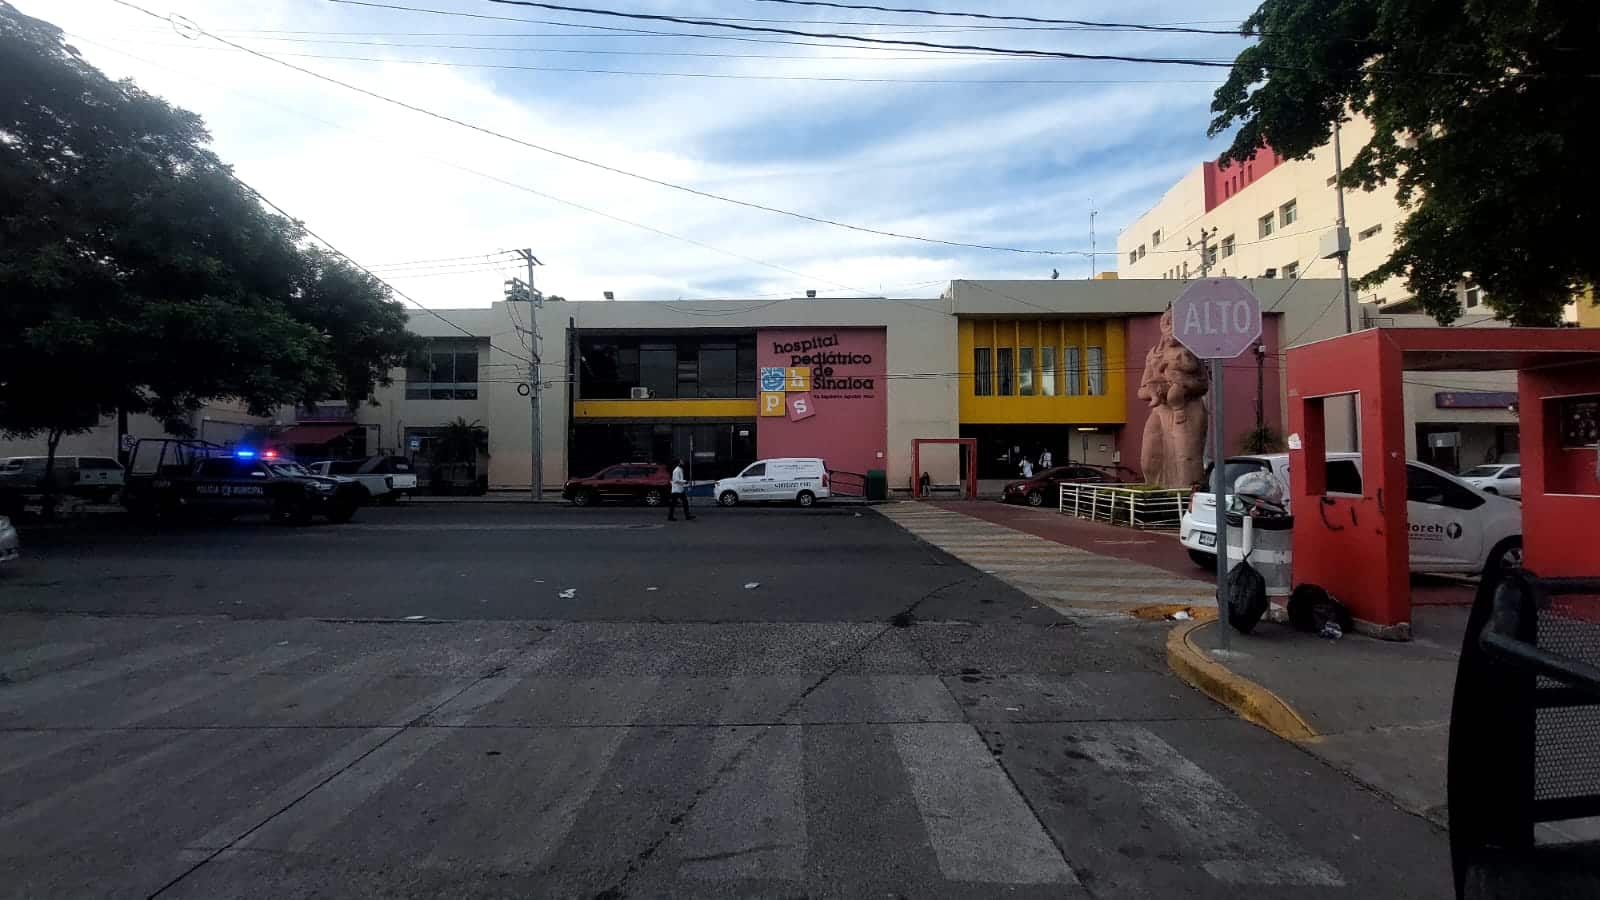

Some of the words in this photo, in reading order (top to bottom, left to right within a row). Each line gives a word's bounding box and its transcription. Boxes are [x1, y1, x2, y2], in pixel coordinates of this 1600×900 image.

[1183, 300, 1251, 335] ALTO
[773, 334, 839, 354] hospital
[791, 351, 872, 367] pediátrico
[790, 369, 804, 387] h
[813, 364, 834, 377] de
[813, 377, 874, 390] Sinaloa
[767, 395, 780, 412] p
[793, 399, 807, 414] s
